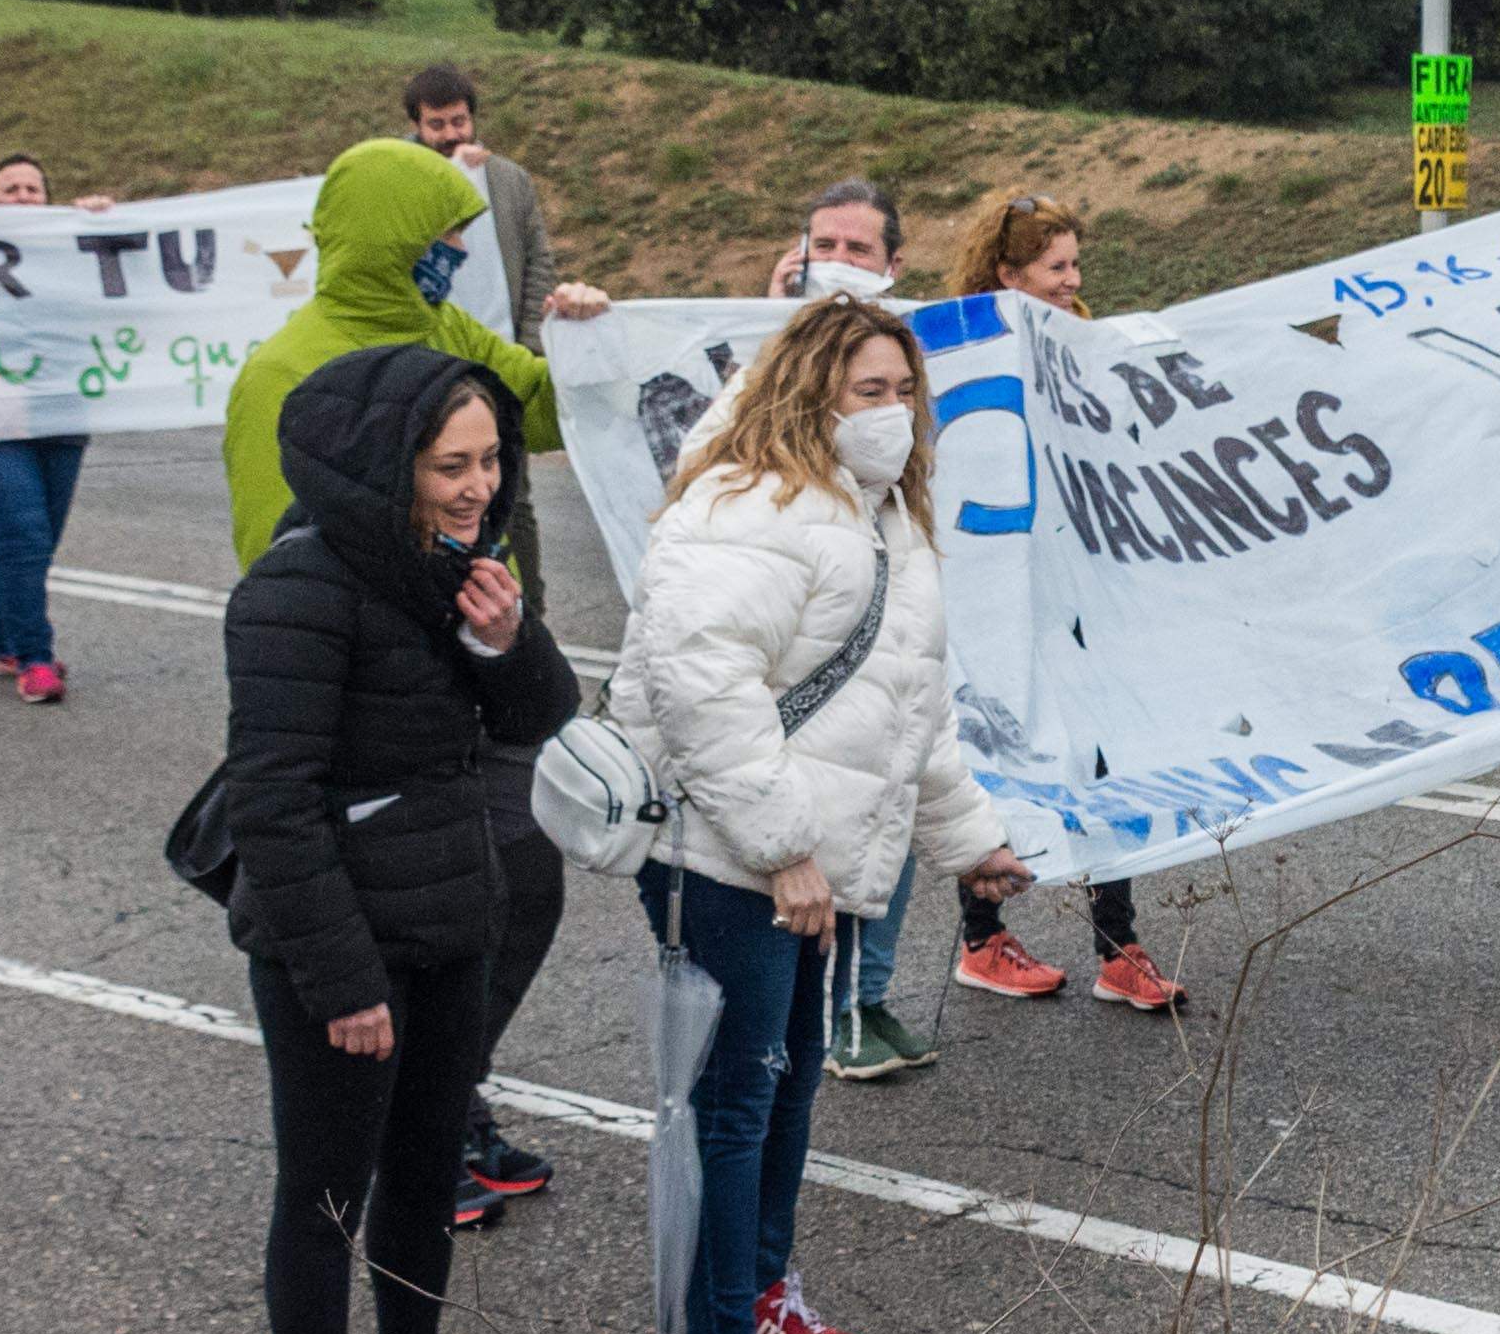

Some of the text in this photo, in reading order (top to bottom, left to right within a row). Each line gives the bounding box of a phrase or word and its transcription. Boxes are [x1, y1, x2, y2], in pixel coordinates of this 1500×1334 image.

[1419, 158, 1445, 205] 20
[76, 228, 217, 299] TU
[1044, 389, 1393, 564] VACANCES
